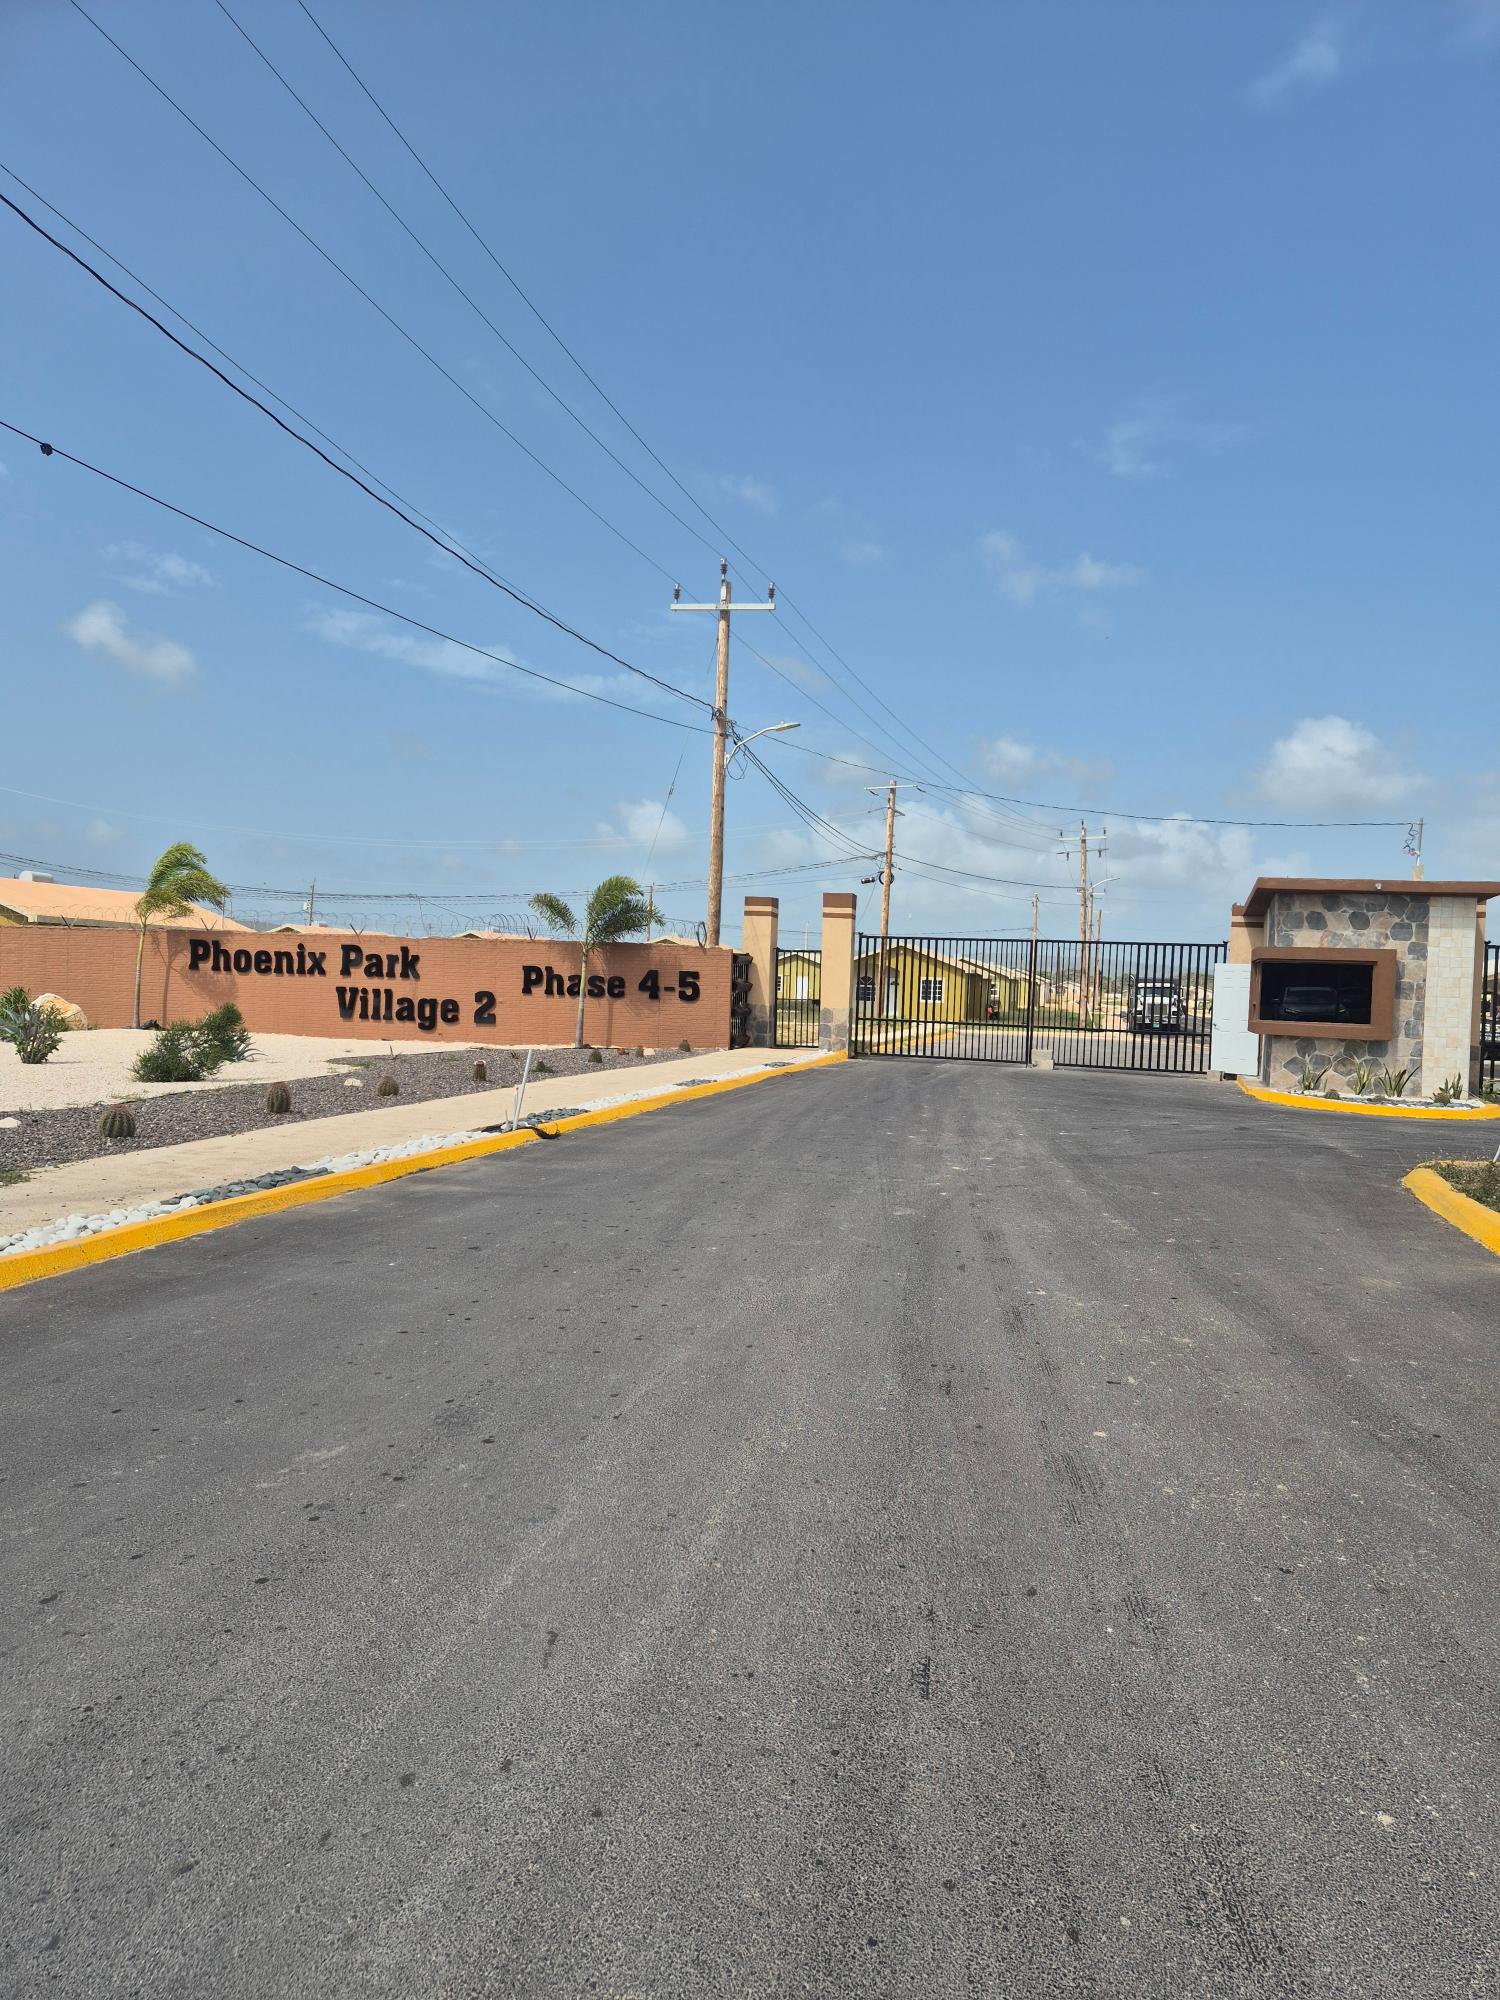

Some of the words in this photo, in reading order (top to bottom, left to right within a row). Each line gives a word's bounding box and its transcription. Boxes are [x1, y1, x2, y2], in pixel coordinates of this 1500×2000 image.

[188, 938, 326, 976] Phoenix
[339, 944, 421, 980] Park
[521, 965, 627, 999] Phase
[637, 969, 701, 1003] 4-5
[335, 986, 460, 1031] Village
[473, 990, 497, 1025] 2
